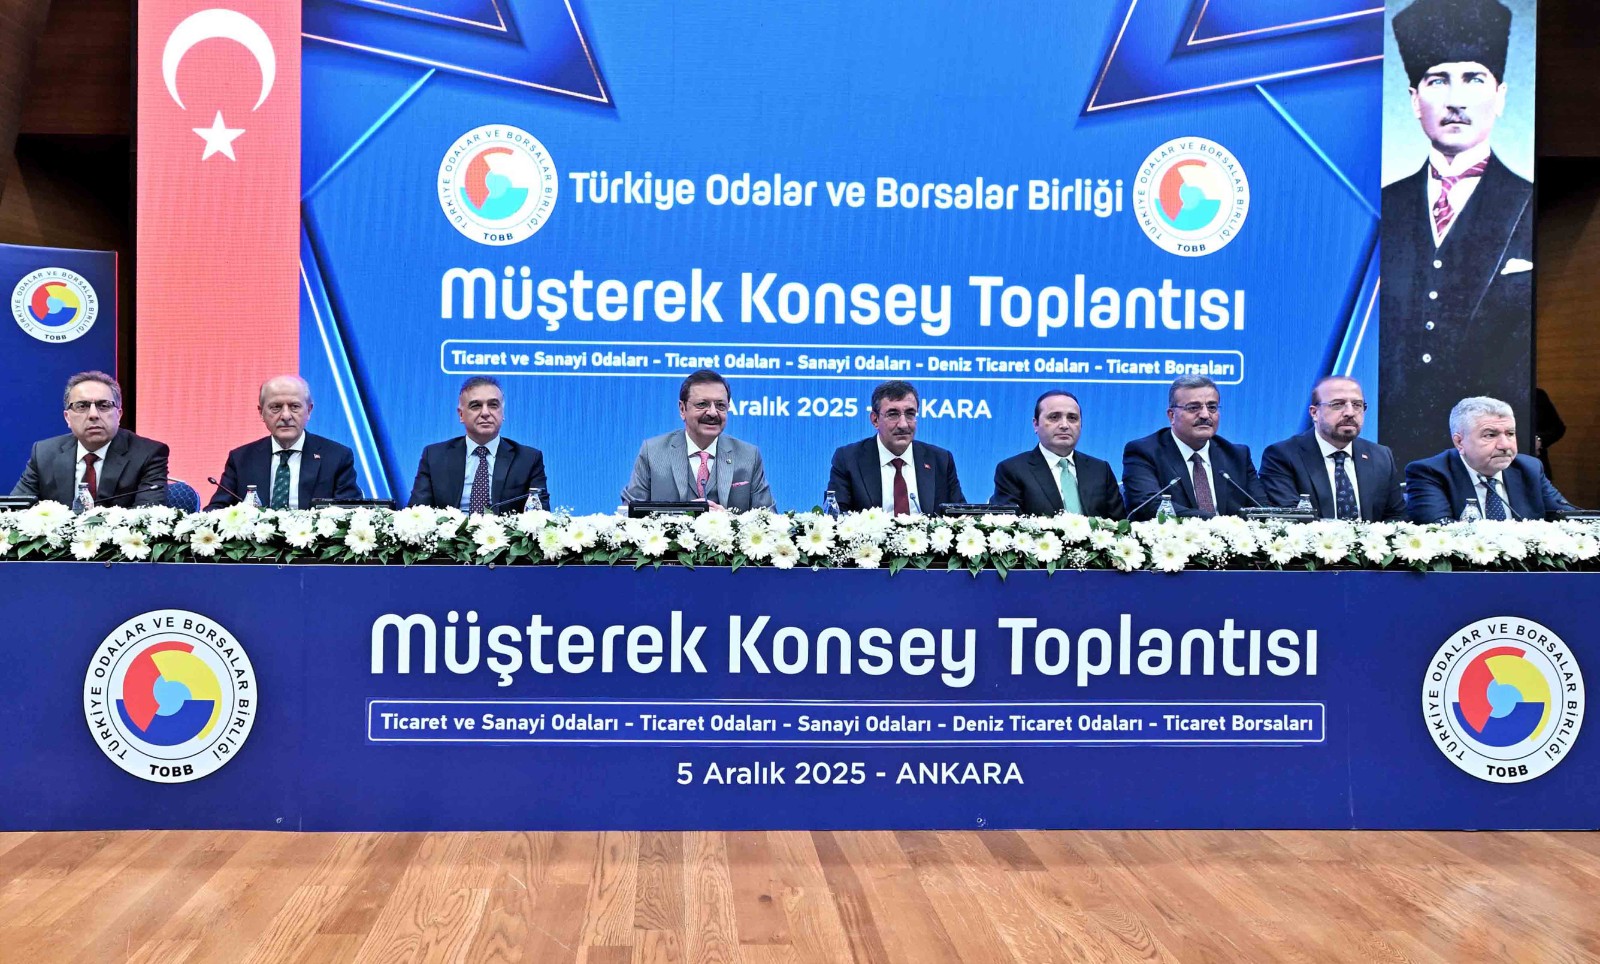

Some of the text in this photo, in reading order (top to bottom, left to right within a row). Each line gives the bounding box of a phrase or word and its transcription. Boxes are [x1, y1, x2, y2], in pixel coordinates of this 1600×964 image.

[445, 134, 481, 172] ODALAR
[485, 129, 500, 138] VE
[506, 131, 552, 181] BORSALAR
[1140, 146, 1175, 184] ODALAR
[1179, 141, 1194, 150] VE
[1199, 143, 1244, 193] BORSALAR
[568, 170, 1123, 218] Türkiye Odalar ve Borsalar Birliği
[483, 232, 514, 241] TOBB
[1177, 243, 1206, 252] TOBB
[17, 272, 43, 296] ODALAR
[61, 271, 95, 304] BORSALAR
[441, 265, 1245, 338] Müşterek Konsey Toplantısı
[451, 350, 507, 366] Ticaret
[510, 354, 530, 366] ve
[533, 351, 587, 371] Sanayi
[591, 352, 649, 367] Odaları
[665, 352, 720, 369] Ticaret
[724, 354, 781, 369] Odaları
[797, 354, 851, 374] Sanayi
[854, 355, 911, 371] Odaları
[927, 356, 972, 372] Deniz
[975, 356, 1030, 373] Ticaret
[1034, 357, 1090, 373] Odaları
[1106, 358, 1160, 375] Ticaret
[1164, 359, 1235, 376] Borsaları
[797, 397, 858, 417] 2025
[916, 399, 992, 419] KARA
[371, 610, 1318, 688] Müşterek Konsey Toplantısı
[90, 616, 251, 761] TÜRKİYE ODALAR VE BORSALAR BİRLİĞİ
[1428, 623, 1578, 762] TÜRKİYE ODALAR VE BORSALAR BİRLİĞİ
[381, 713, 448, 730] Ticaret
[453, 717, 476, 731] ve
[481, 713, 545, 735] Sanayi
[551, 713, 618, 731] Odaları
[639, 714, 705, 732] Ticaret
[710, 714, 777, 732] Odaları
[797, 715, 860, 736] Sanayi
[865, 715, 931, 732] Odaları
[953, 715, 1004, 732] Deniz
[1009, 715, 1073, 732] Ticaret
[1078, 714, 1143, 732] Odaları
[1162, 714, 1226, 731] Ticaret
[1231, 714, 1313, 731] Borsaları
[149, 763, 194, 777] TOBB
[676, 762, 693, 785] 5
[703, 761, 786, 785] Aralık
[794, 761, 866, 785] 2025
[896, 762, 1024, 785] ANKARA
[1486, 764, 1529, 778] TOBB
